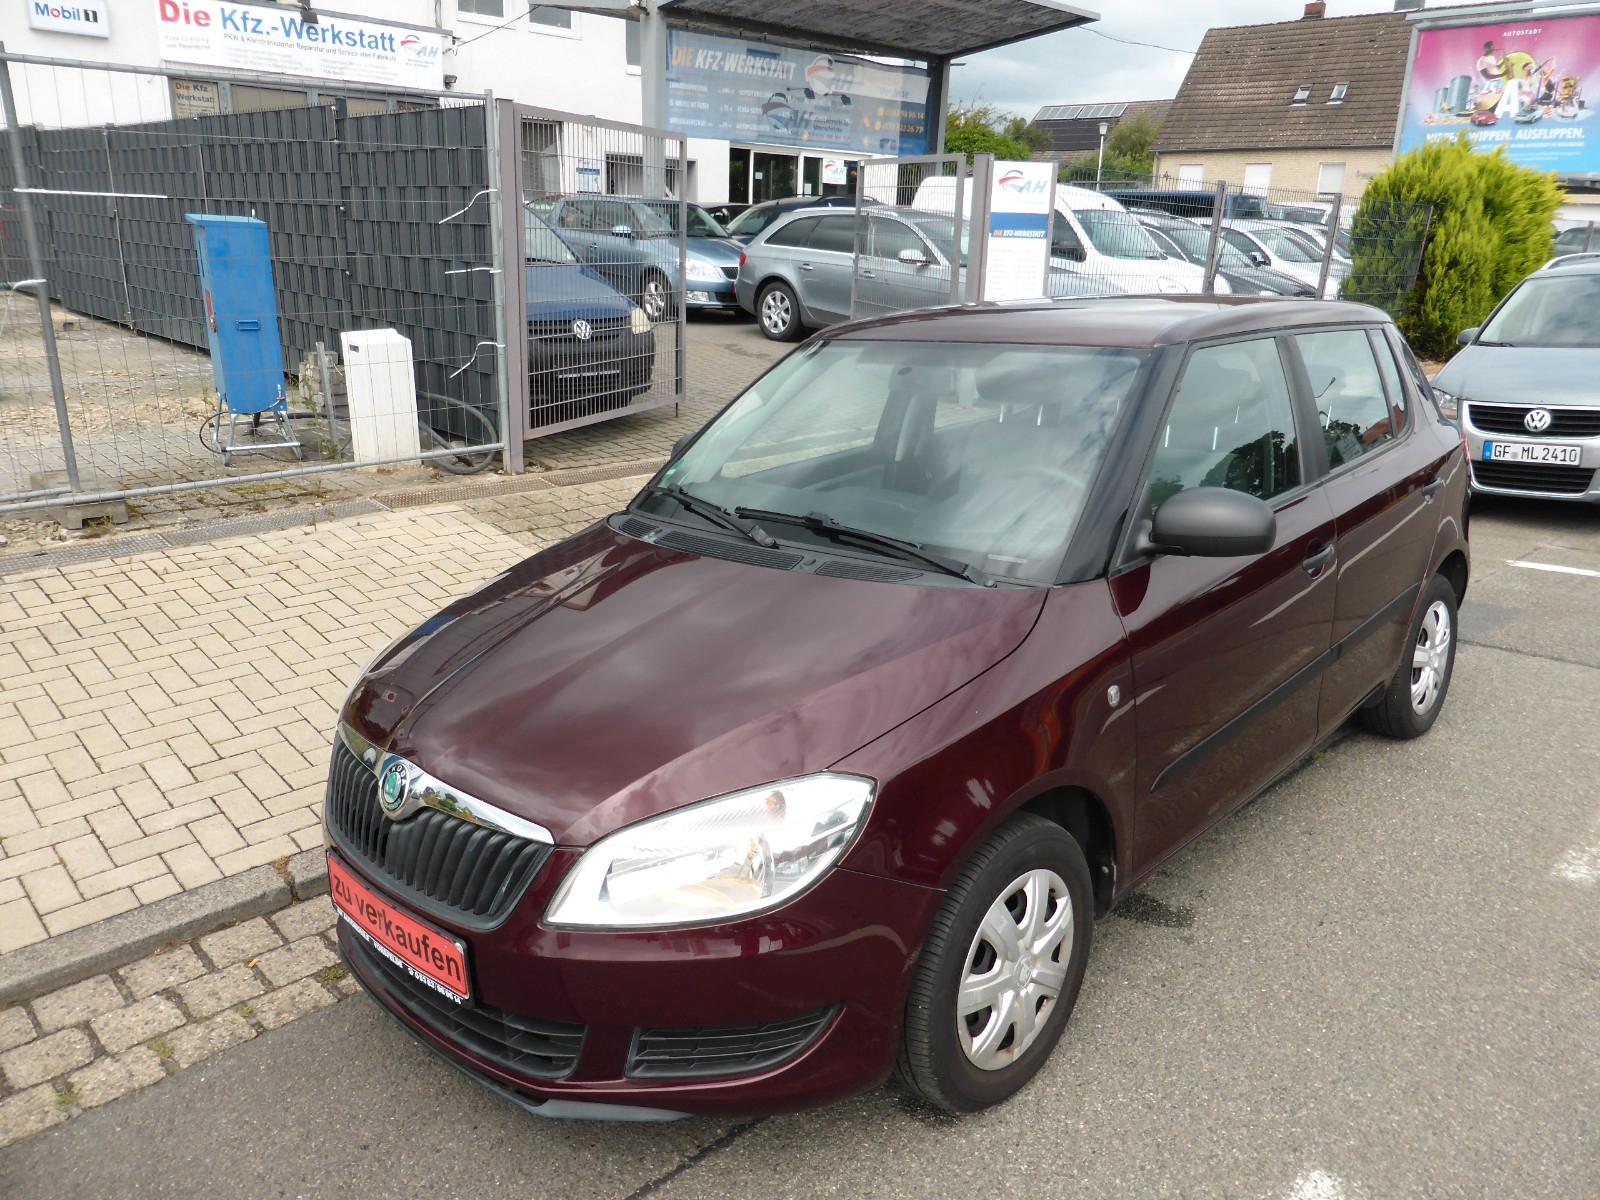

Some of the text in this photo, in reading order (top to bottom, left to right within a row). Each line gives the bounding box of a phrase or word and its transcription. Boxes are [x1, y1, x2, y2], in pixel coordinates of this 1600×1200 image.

[34, 2, 98, 23] Mobil 1
[159, 0, 396, 53] Die Kfz.-Werkstatt
[1502, 28, 1543, 37] AUTOSTADT
[223, 33, 239, 41] PKW
[416, 45, 440, 58] AH
[672, 47, 693, 68] DIE
[175, 82, 208, 92] Die Kfz
[1515, 128, 1585, 140] AUSFLIPPEN.
[1021, 180, 1048, 193] AH
[1494, 445, 1577, 463] GF ML 2410
[333, 873, 353, 905] zu
[354, 894, 462, 982] verkaufen
